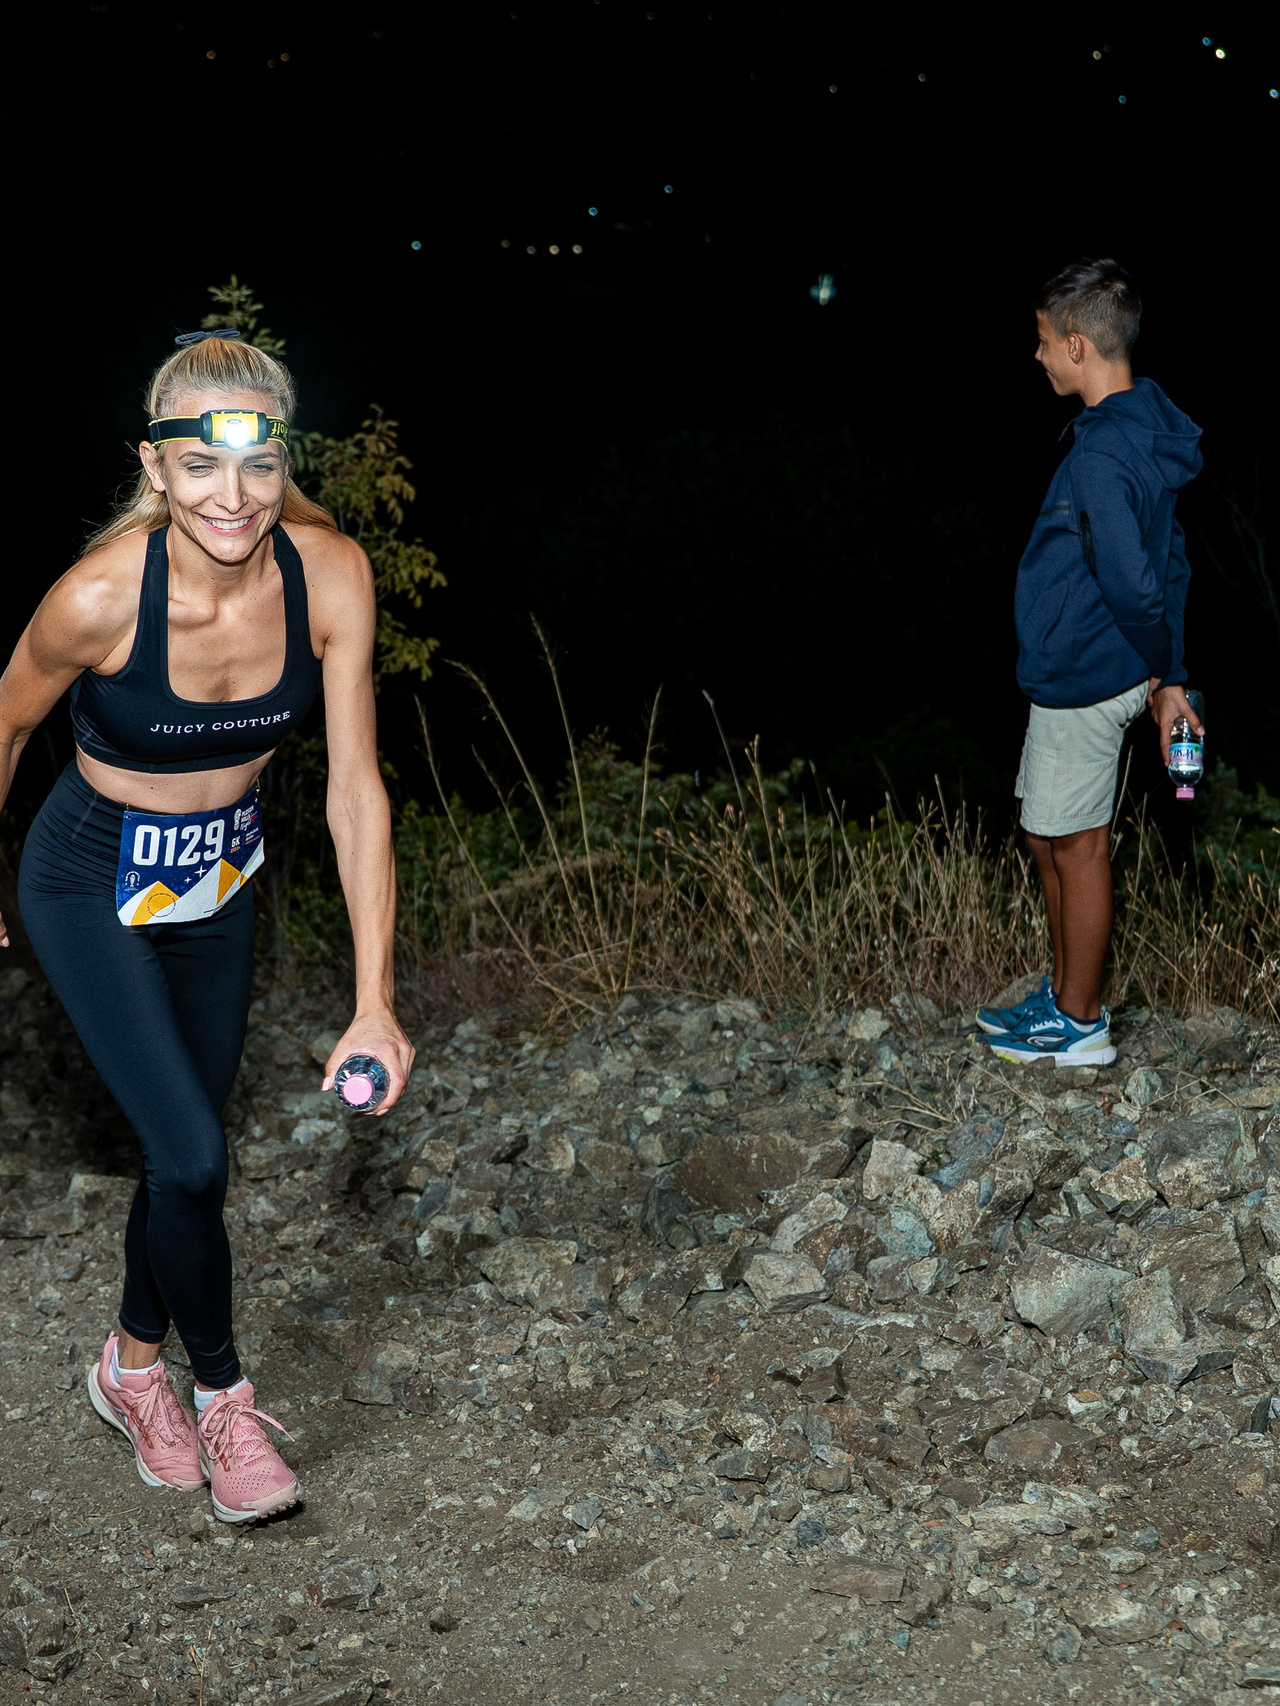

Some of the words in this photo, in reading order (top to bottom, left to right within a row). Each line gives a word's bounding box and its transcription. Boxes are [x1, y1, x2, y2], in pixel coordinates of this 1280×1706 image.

[150, 723, 205, 734] JUICY
[212, 710, 291, 732] COUTURE
[132, 818, 225, 867] 0129
[231, 835, 241, 848] 6K
